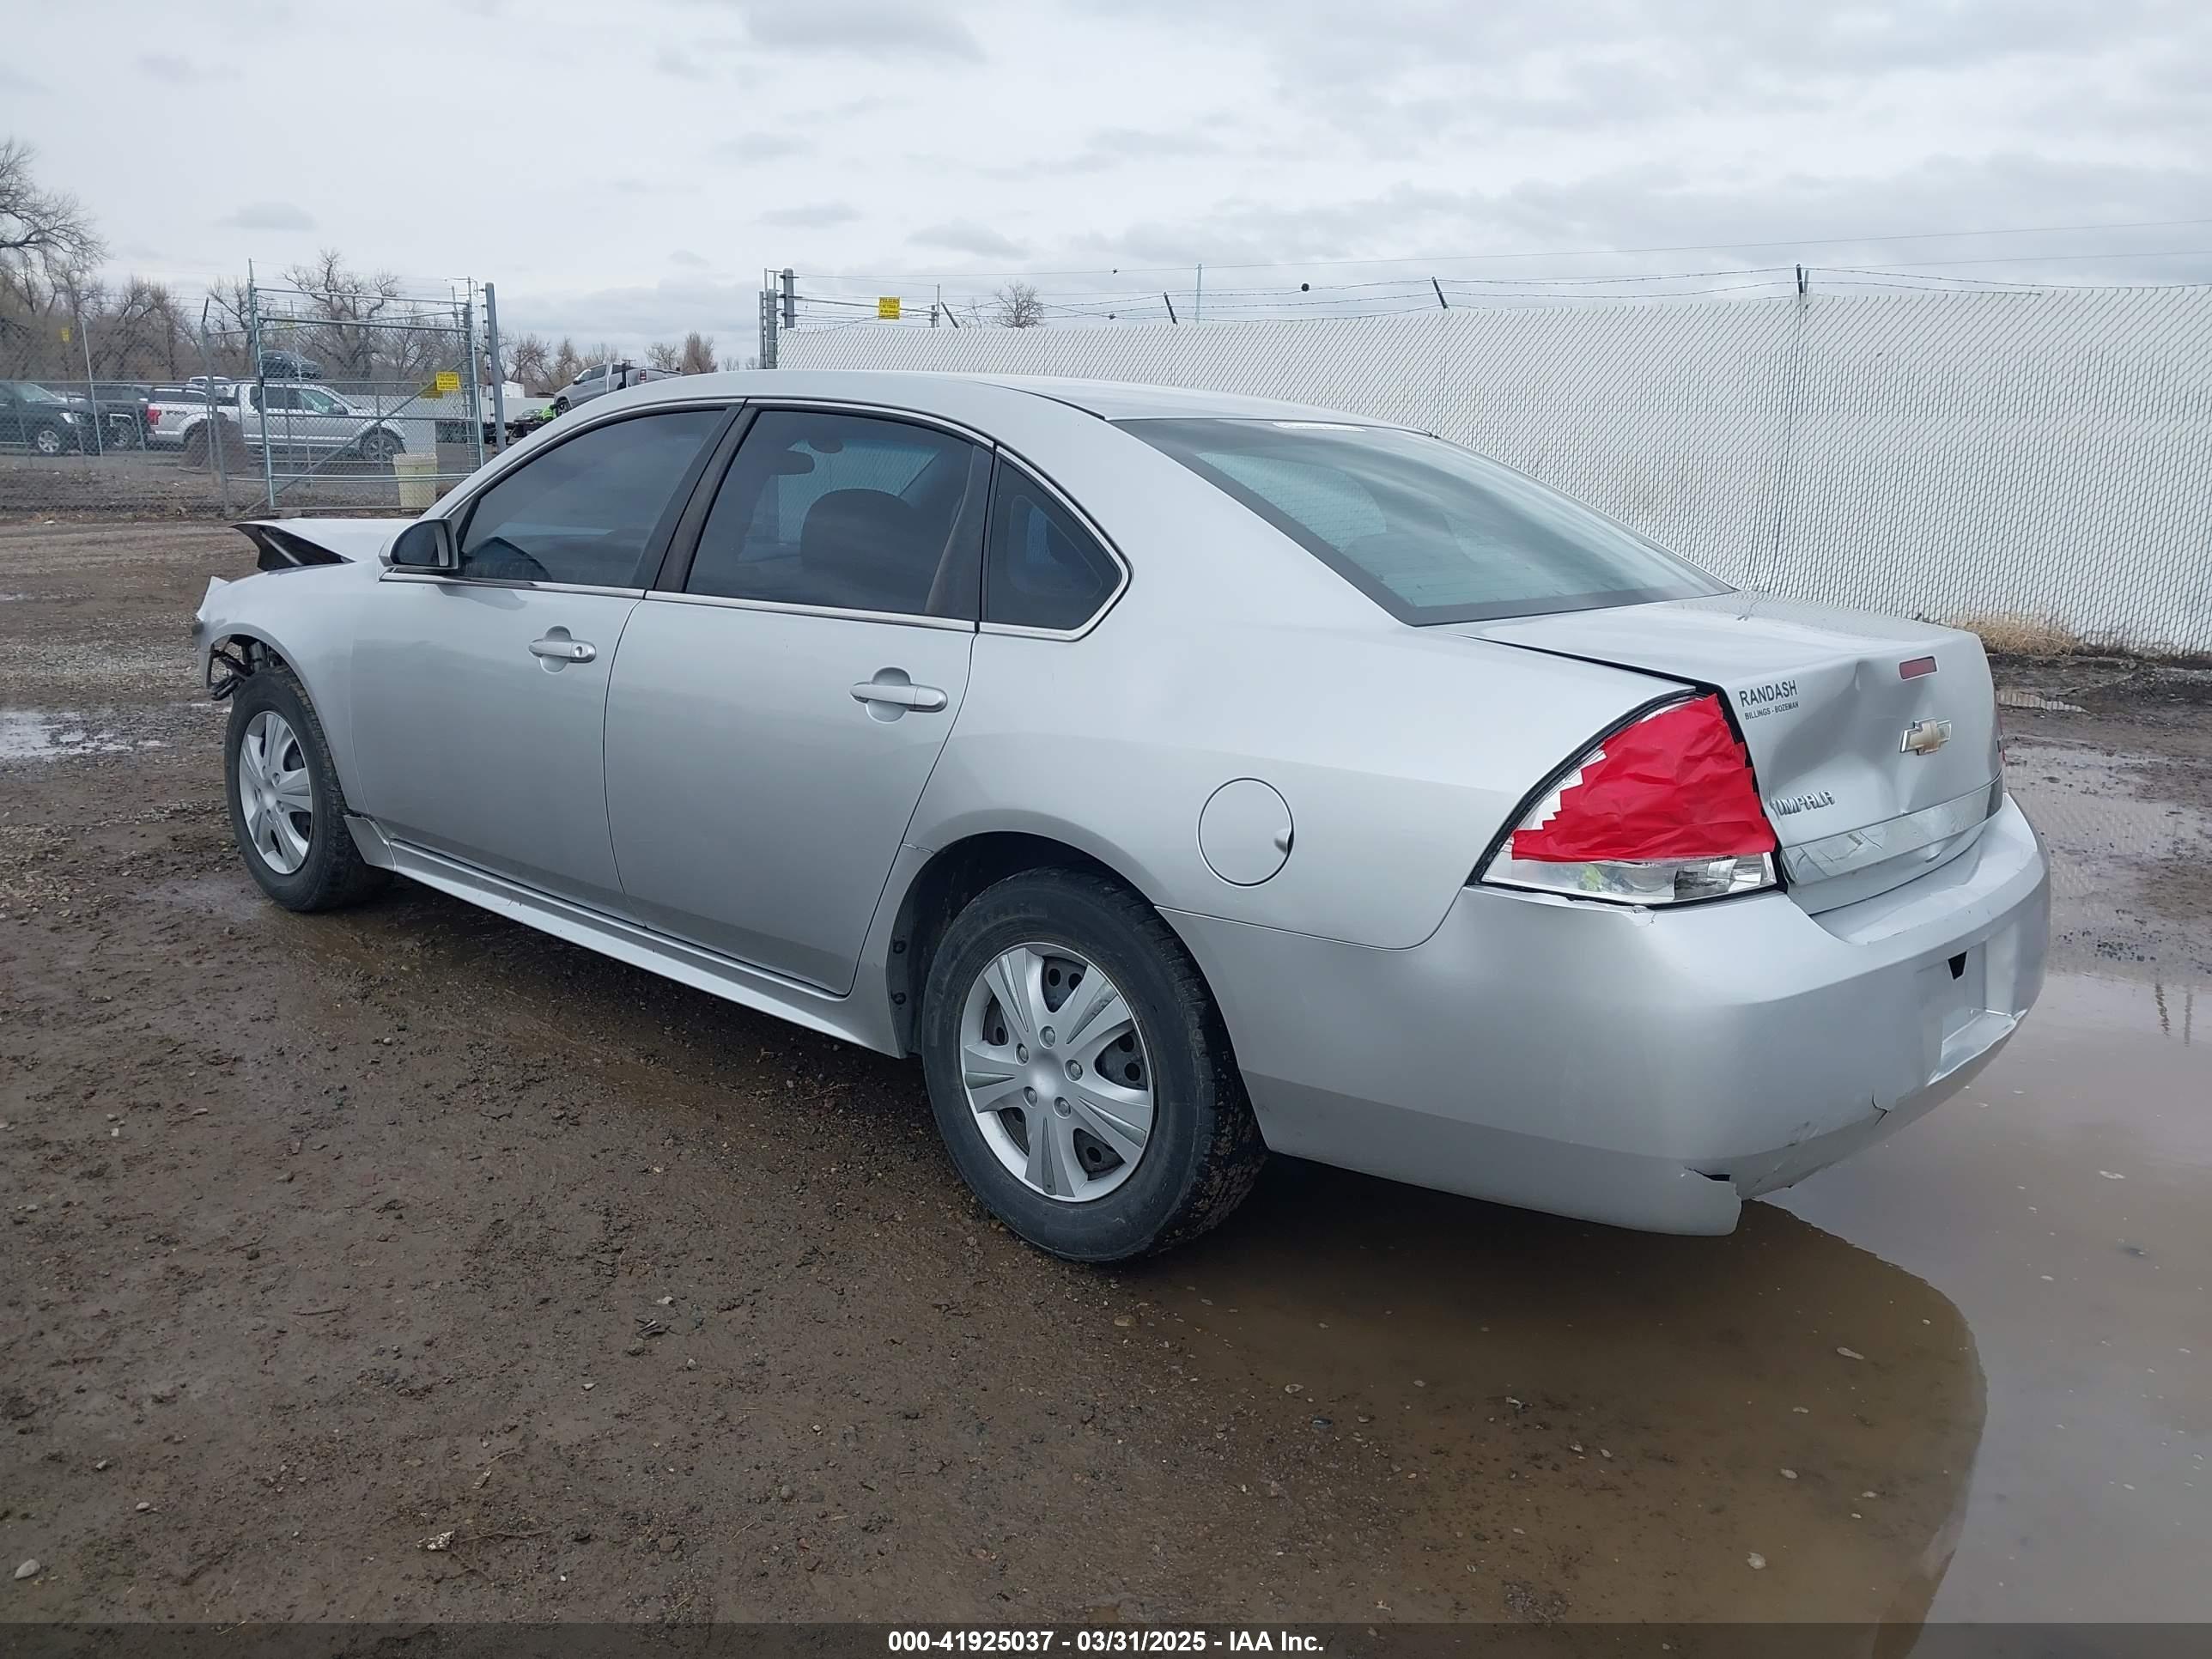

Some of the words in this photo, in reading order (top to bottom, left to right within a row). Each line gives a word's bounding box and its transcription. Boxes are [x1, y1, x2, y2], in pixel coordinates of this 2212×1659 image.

[1739, 679, 1797, 708] RANDASH
[1745, 708, 1771, 720] BILLINGS
[1775, 702, 1799, 713] BOZEMAN
[1775, 791, 1835, 816] IMPALA
